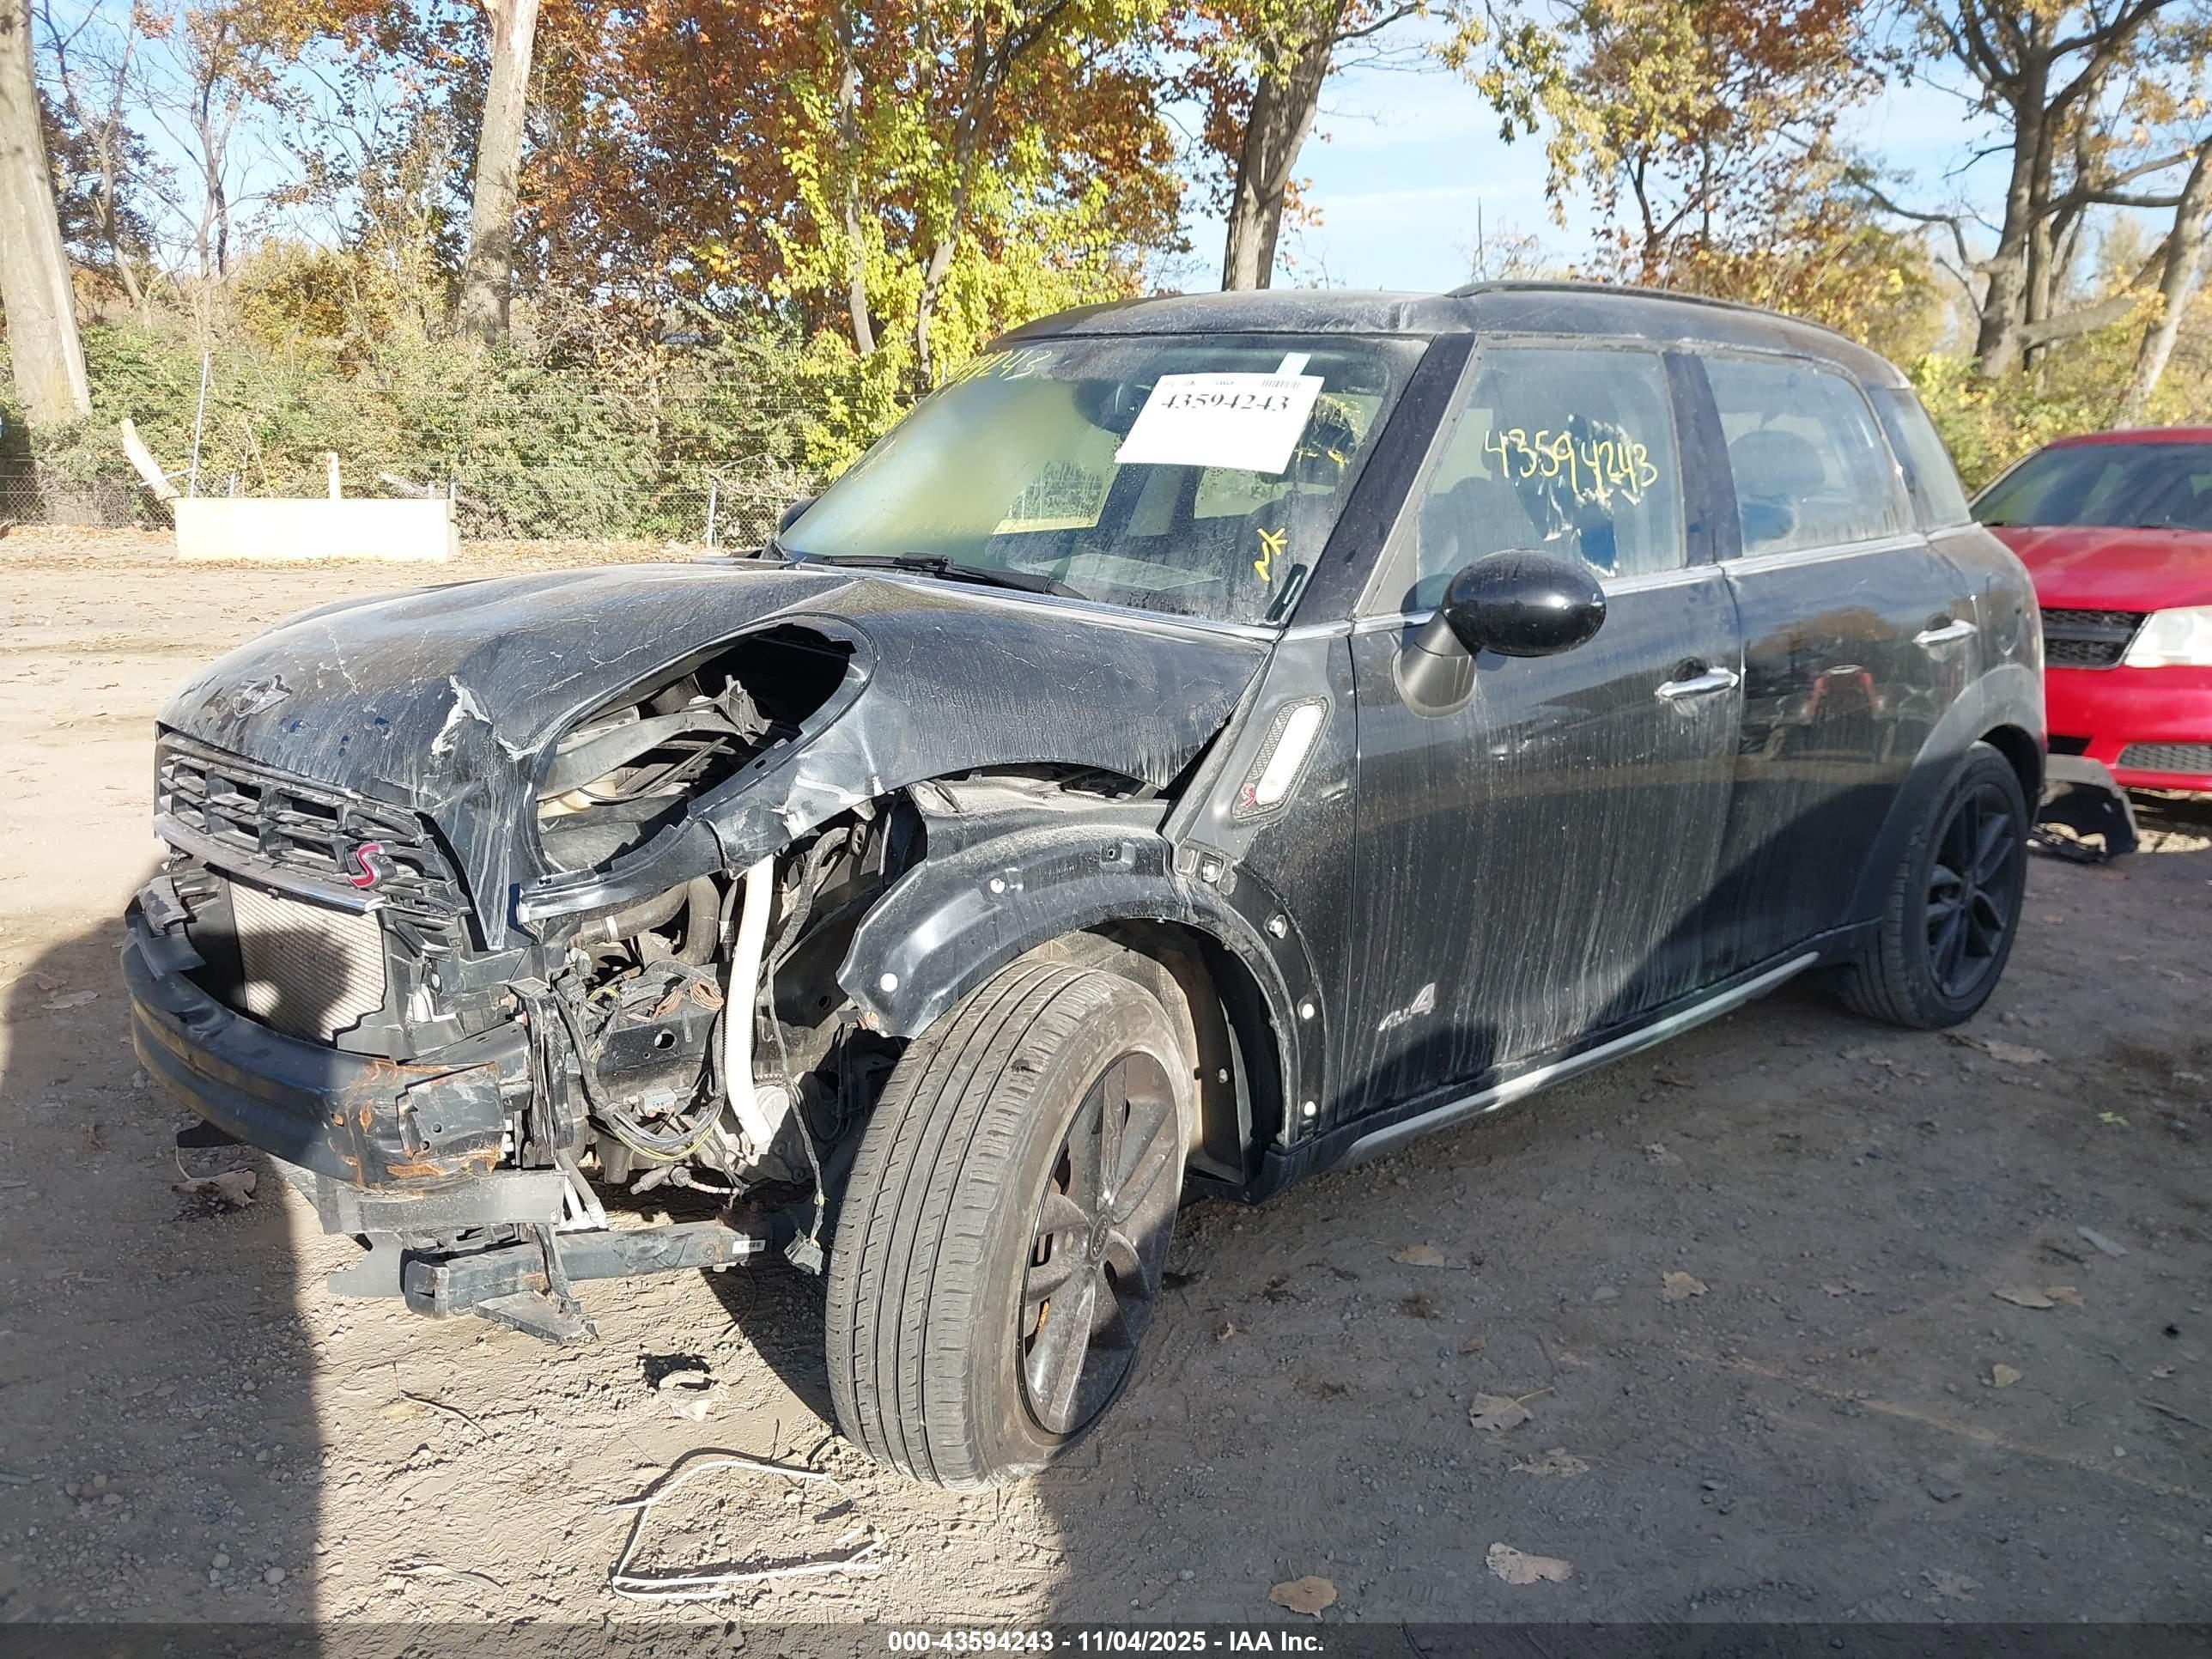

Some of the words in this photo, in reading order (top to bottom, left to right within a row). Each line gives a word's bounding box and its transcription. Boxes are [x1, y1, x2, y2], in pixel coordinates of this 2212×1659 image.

[1161, 393, 1290, 412] 43594243
[1485, 428, 1658, 495] 43594243
[349, 842, 384, 888] S
